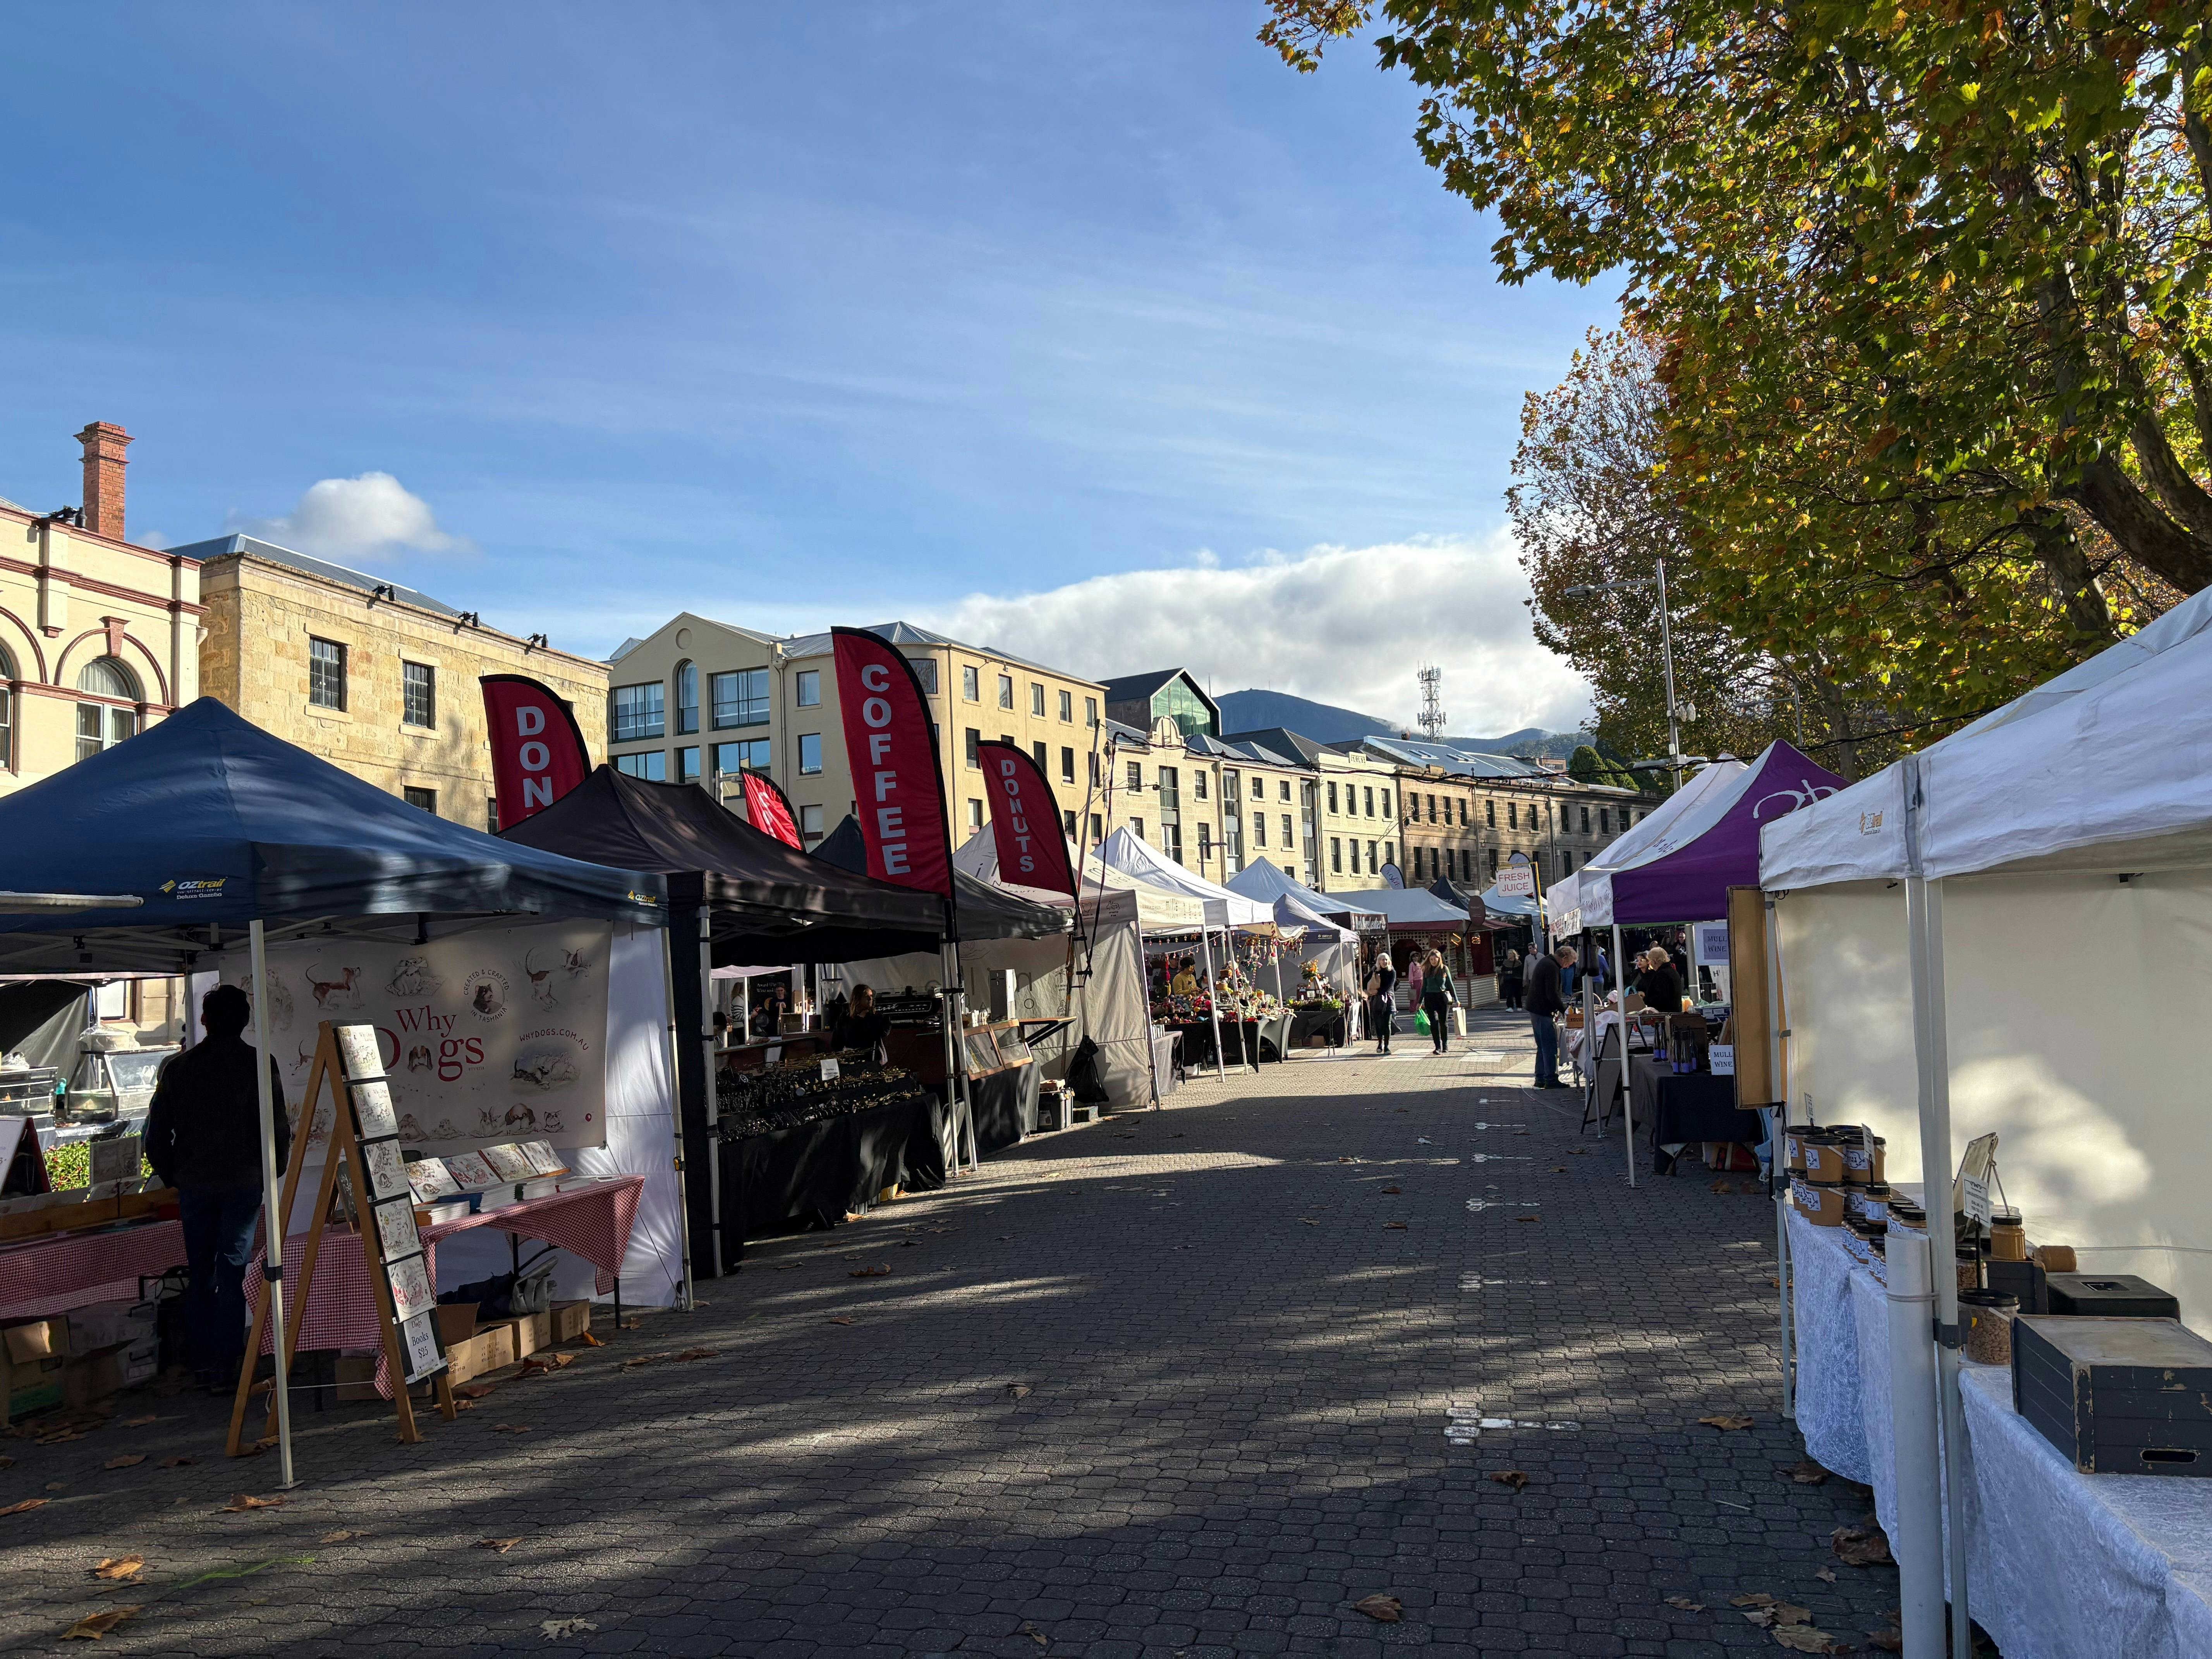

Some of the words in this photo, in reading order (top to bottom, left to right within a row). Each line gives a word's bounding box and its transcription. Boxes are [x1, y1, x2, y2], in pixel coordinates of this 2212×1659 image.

[516, 706, 553, 818] DON
[861, 665, 911, 875] COFFEE
[1001, 759, 1034, 872] DONUTS
[1499, 872, 1530, 882] FRESH
[1502, 883, 1529, 891] JUICE
[464, 971, 480, 995] CREATED
[488, 969, 509, 990] CRAFTED
[394, 1005, 457, 1038] Why
[479, 1007, 507, 1022] TASMANIA
[519, 1028, 589, 1050] WHYDOGS.COM.AU
[412, 1332, 429, 1346] Books
[418, 1346, 428, 1358] $25
